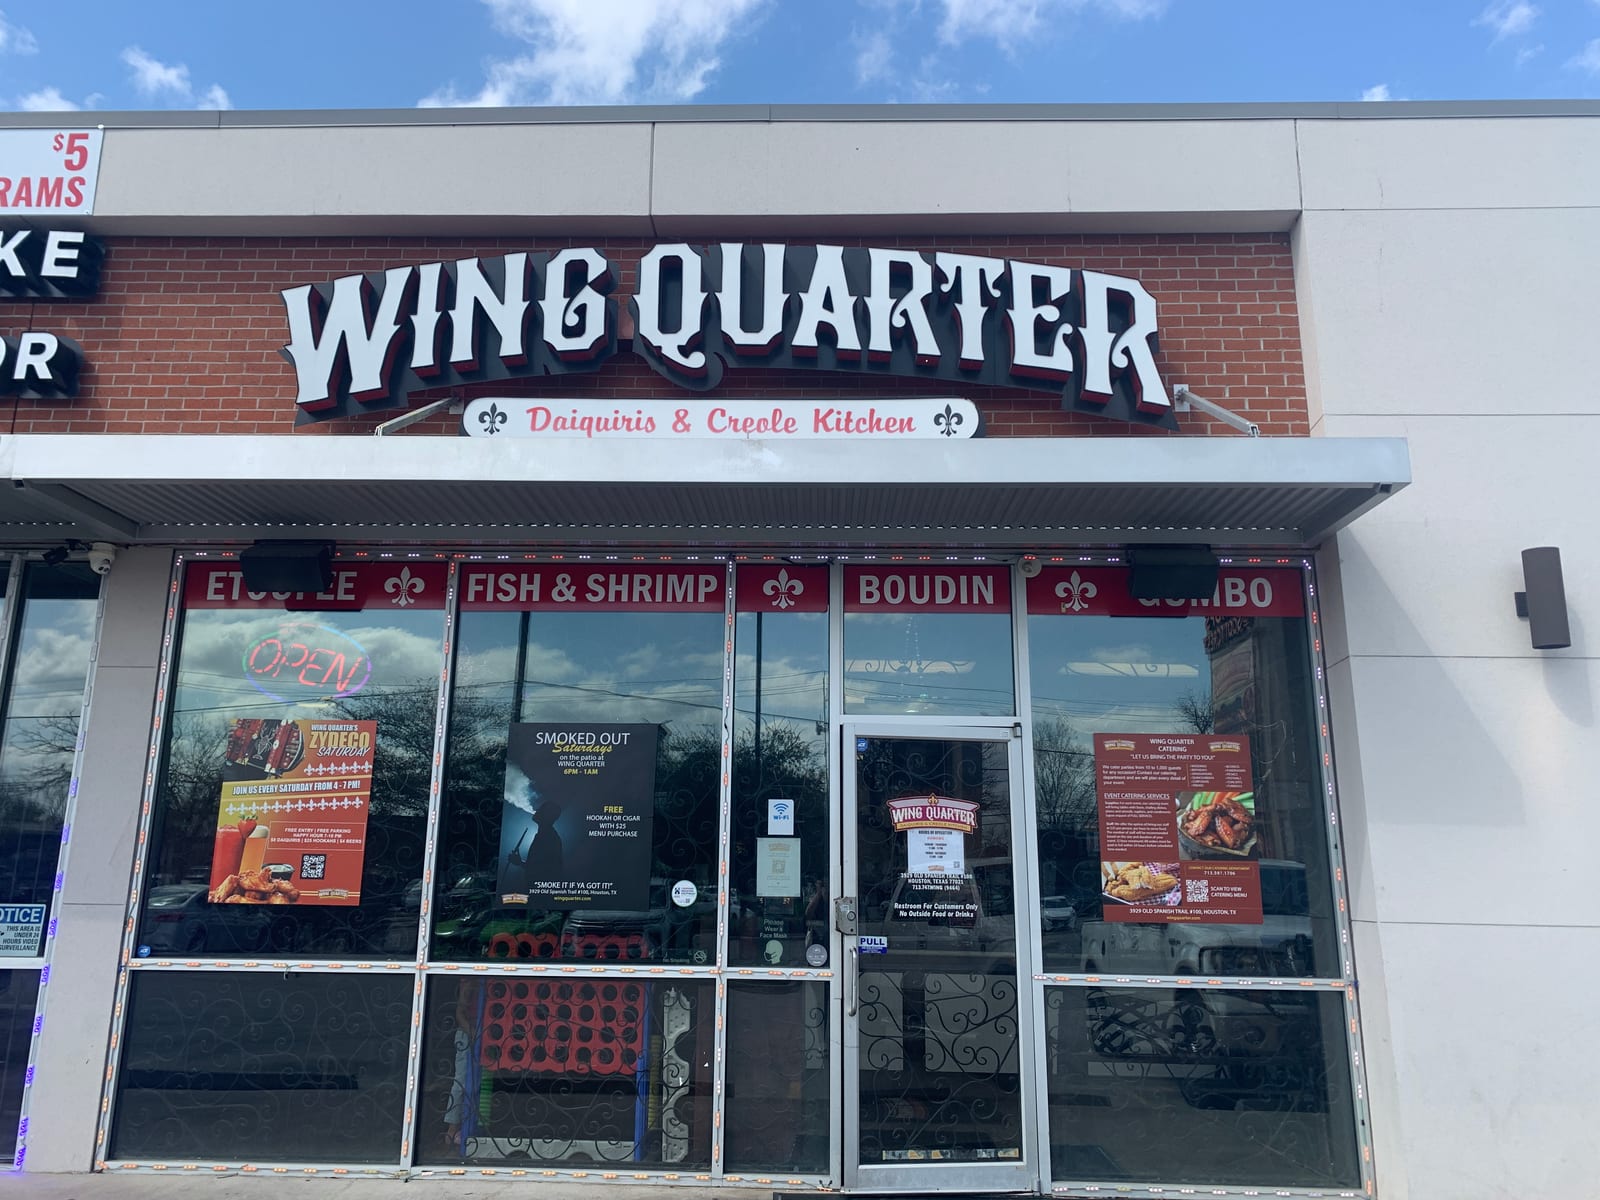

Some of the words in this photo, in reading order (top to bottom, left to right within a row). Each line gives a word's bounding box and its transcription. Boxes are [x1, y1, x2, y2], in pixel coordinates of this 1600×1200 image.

[52, 132, 90, 172] $5
[281, 246, 608, 408] WING
[633, 242, 1172, 409] QUARTER
[0, 331, 59, 380] R
[525, 406, 657, 439] Daiquiris
[671, 407, 692, 434] &
[707, 407, 799, 434] Creole
[813, 407, 918, 434] Kitchen
[466, 572, 546, 603] FISH
[551, 573, 577, 603] &
[585, 572, 719, 604] SHRIMP
[859, 574, 995, 605] BOUDIN
[249, 638, 363, 693] OPEN
[309, 732, 370, 749] ZYDECO
[317, 746, 371, 757] SATURDAY
[536, 732, 596, 745] SMOKED
[600, 732, 631, 745] OUT
[552, 741, 613, 756] Saturdays
[232, 786, 248, 795] JOIN
[248, 786, 258, 794] US
[258, 784, 278, 794] EVERY
[279, 782, 314, 792] SATURDAY
[314, 782, 332, 791] FROM
[333, 782, 338, 790] 4
[892, 806, 923, 823] WING
[926, 806, 975, 826] QUARTER
